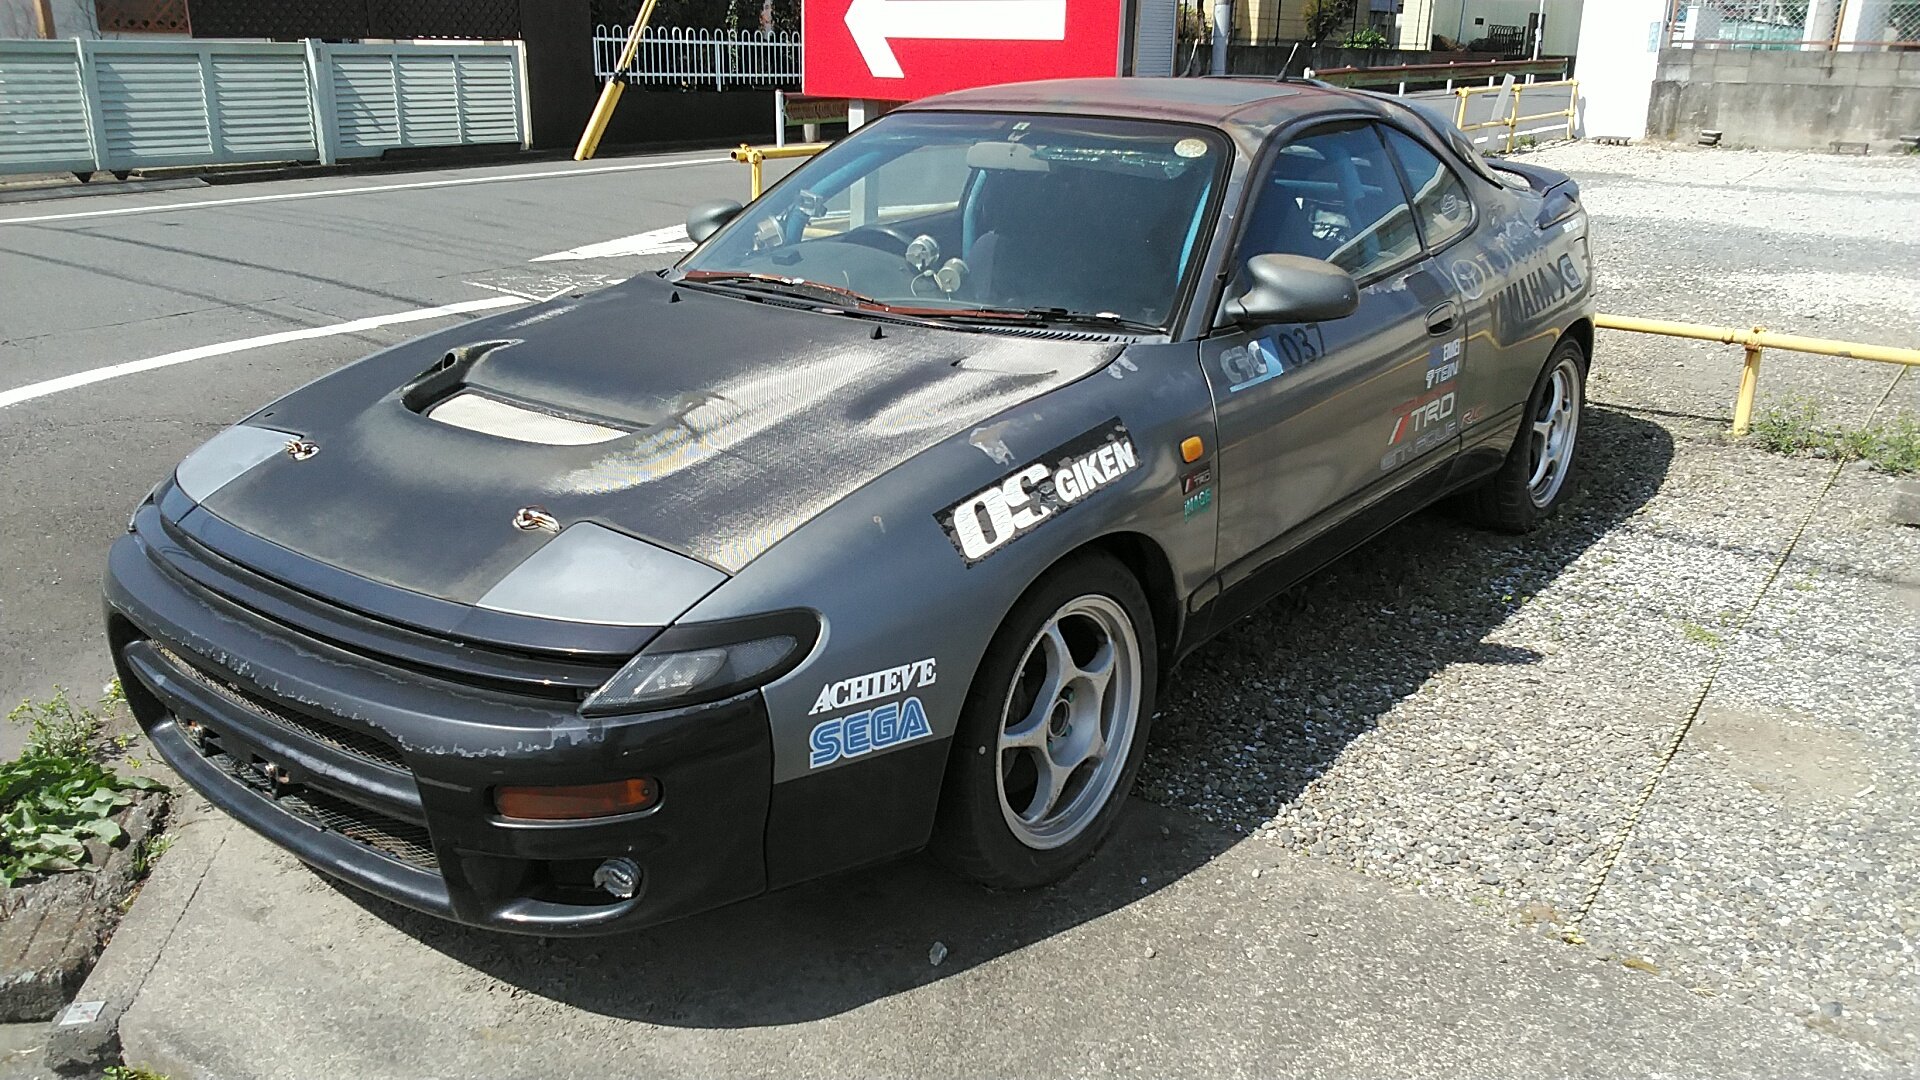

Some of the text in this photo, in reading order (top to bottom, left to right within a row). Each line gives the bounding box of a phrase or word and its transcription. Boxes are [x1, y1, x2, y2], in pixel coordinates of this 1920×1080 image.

[1488, 266, 1557, 324] YAMAHA
[1279, 323, 1325, 367] 037
[1433, 360, 1459, 384] TEIN
[1411, 392, 1455, 431] TRD
[954, 442, 1136, 559] OS GIKEN
[808, 658, 936, 715] ACHIEVE
[809, 697, 933, 769] SEGA
